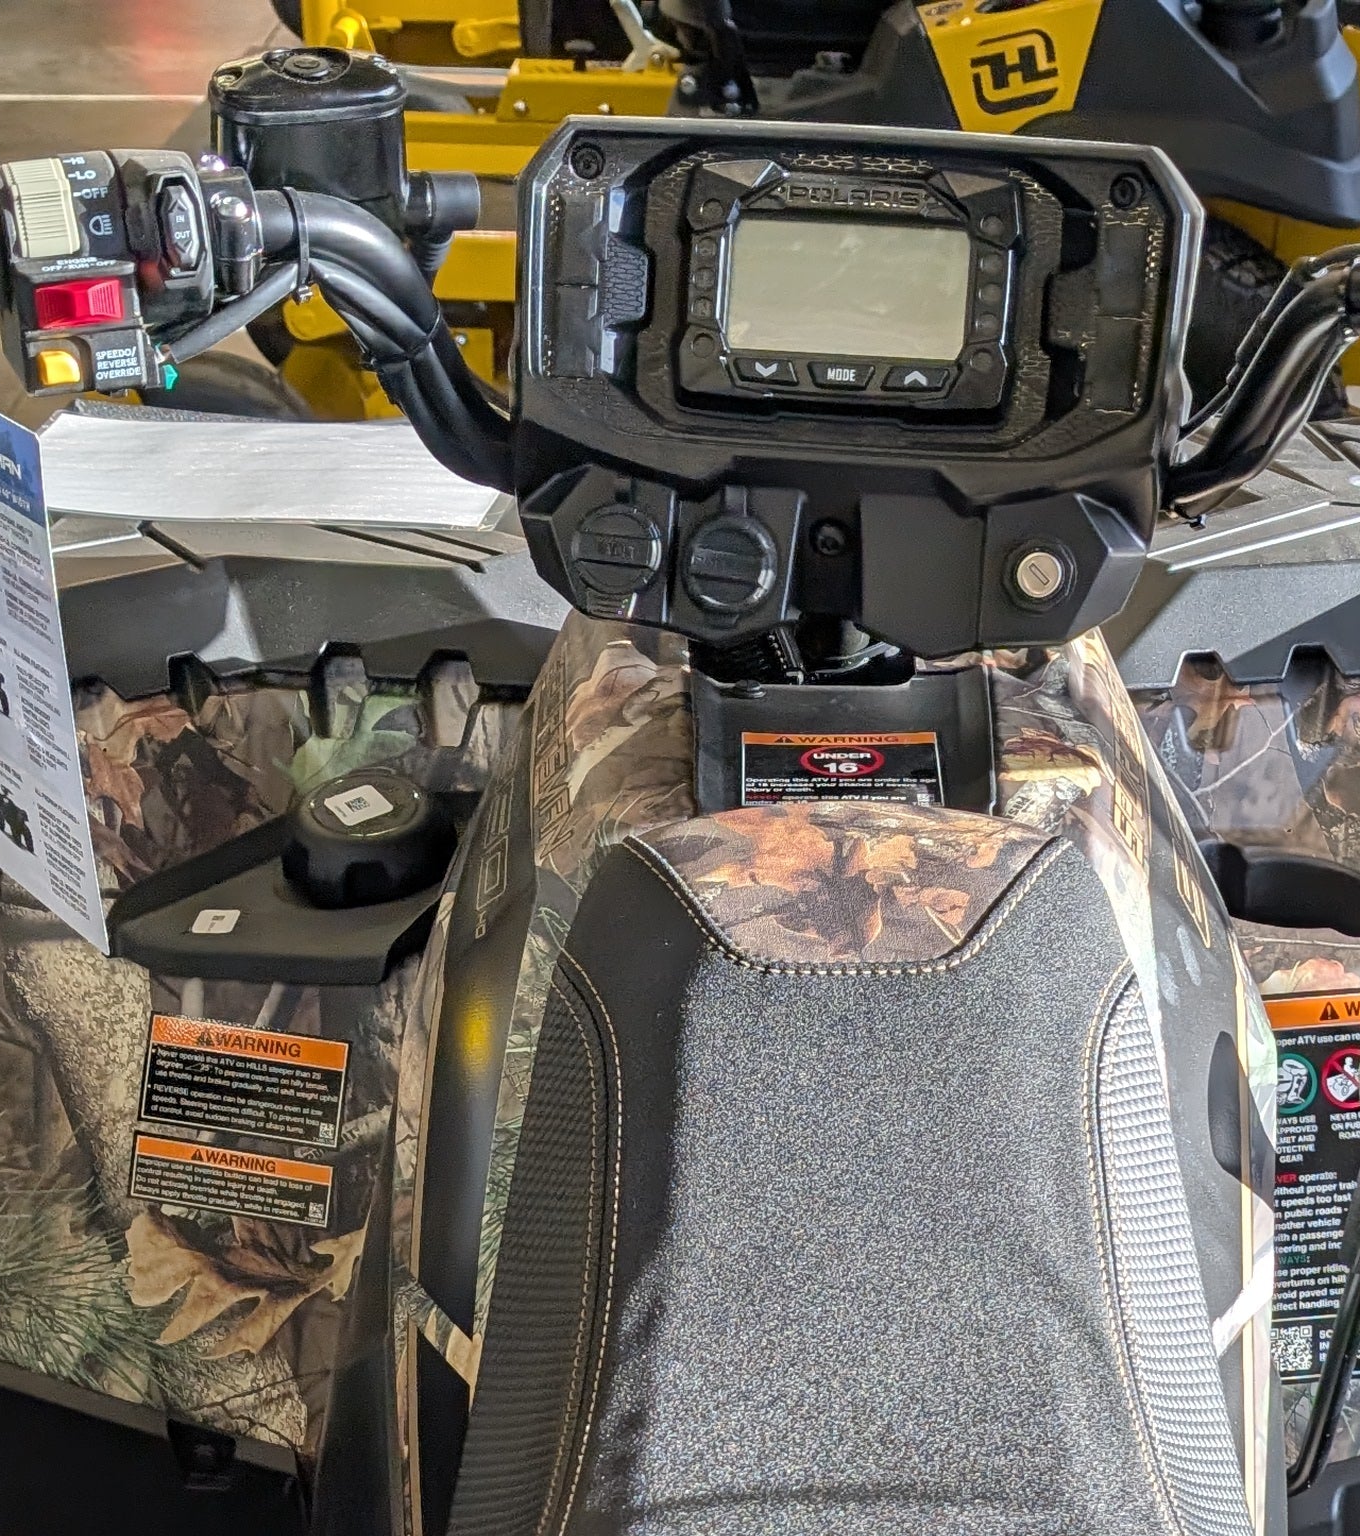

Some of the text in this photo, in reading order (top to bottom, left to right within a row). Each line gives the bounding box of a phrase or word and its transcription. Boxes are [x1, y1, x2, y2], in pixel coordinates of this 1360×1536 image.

[76, 170, 97, 180] LO
[82, 187, 108, 199] OFF
[788, 185, 921, 208] POLARIS
[174, 231, 191, 240] OUT
[96, 346, 137, 361] SPEEDO/
[97, 357, 139, 370] REVERSE
[95, 367, 142, 381] OVERRIDE
[827, 367, 857, 382] MODE
[798, 735, 899, 744] WARNING
[813, 752, 871, 760] UNDER
[823, 762, 859, 774] 16
[217, 1033, 302, 1058] WARNING
[1297, 1034, 1351, 1045] ATV use can
[220, 1057, 235, 1066] ATV
[246, 1061, 268, 1072] HILLS
[153, 1083, 189, 1096] REVERSE
[1299, 1115, 1316, 1124] USE
[1330, 1111, 1357, 1122] NEVER
[1331, 1122, 1344, 1131] ON
[1297, 1134, 1316, 1143] AND
[205, 1149, 277, 1174] WARNING
[1279, 1154, 1303, 1164] GEAR
[136, 1174, 146, 1183] Do
[1298, 1171, 1338, 1184] operate:
[1306, 1183, 1337, 1194] proper
[1281, 1192, 1352, 1208] speeds too fast
[1284, 1206, 1342, 1220] public roads
[1306, 1218, 1341, 1229] vehicle
[1308, 1241, 1327, 1252] and
[1290, 1266, 1321, 1278] proper
[1317, 1276, 1330, 1285] on
[1298, 1287, 1328, 1300] paved
[1298, 1299, 1340, 1311] handling
